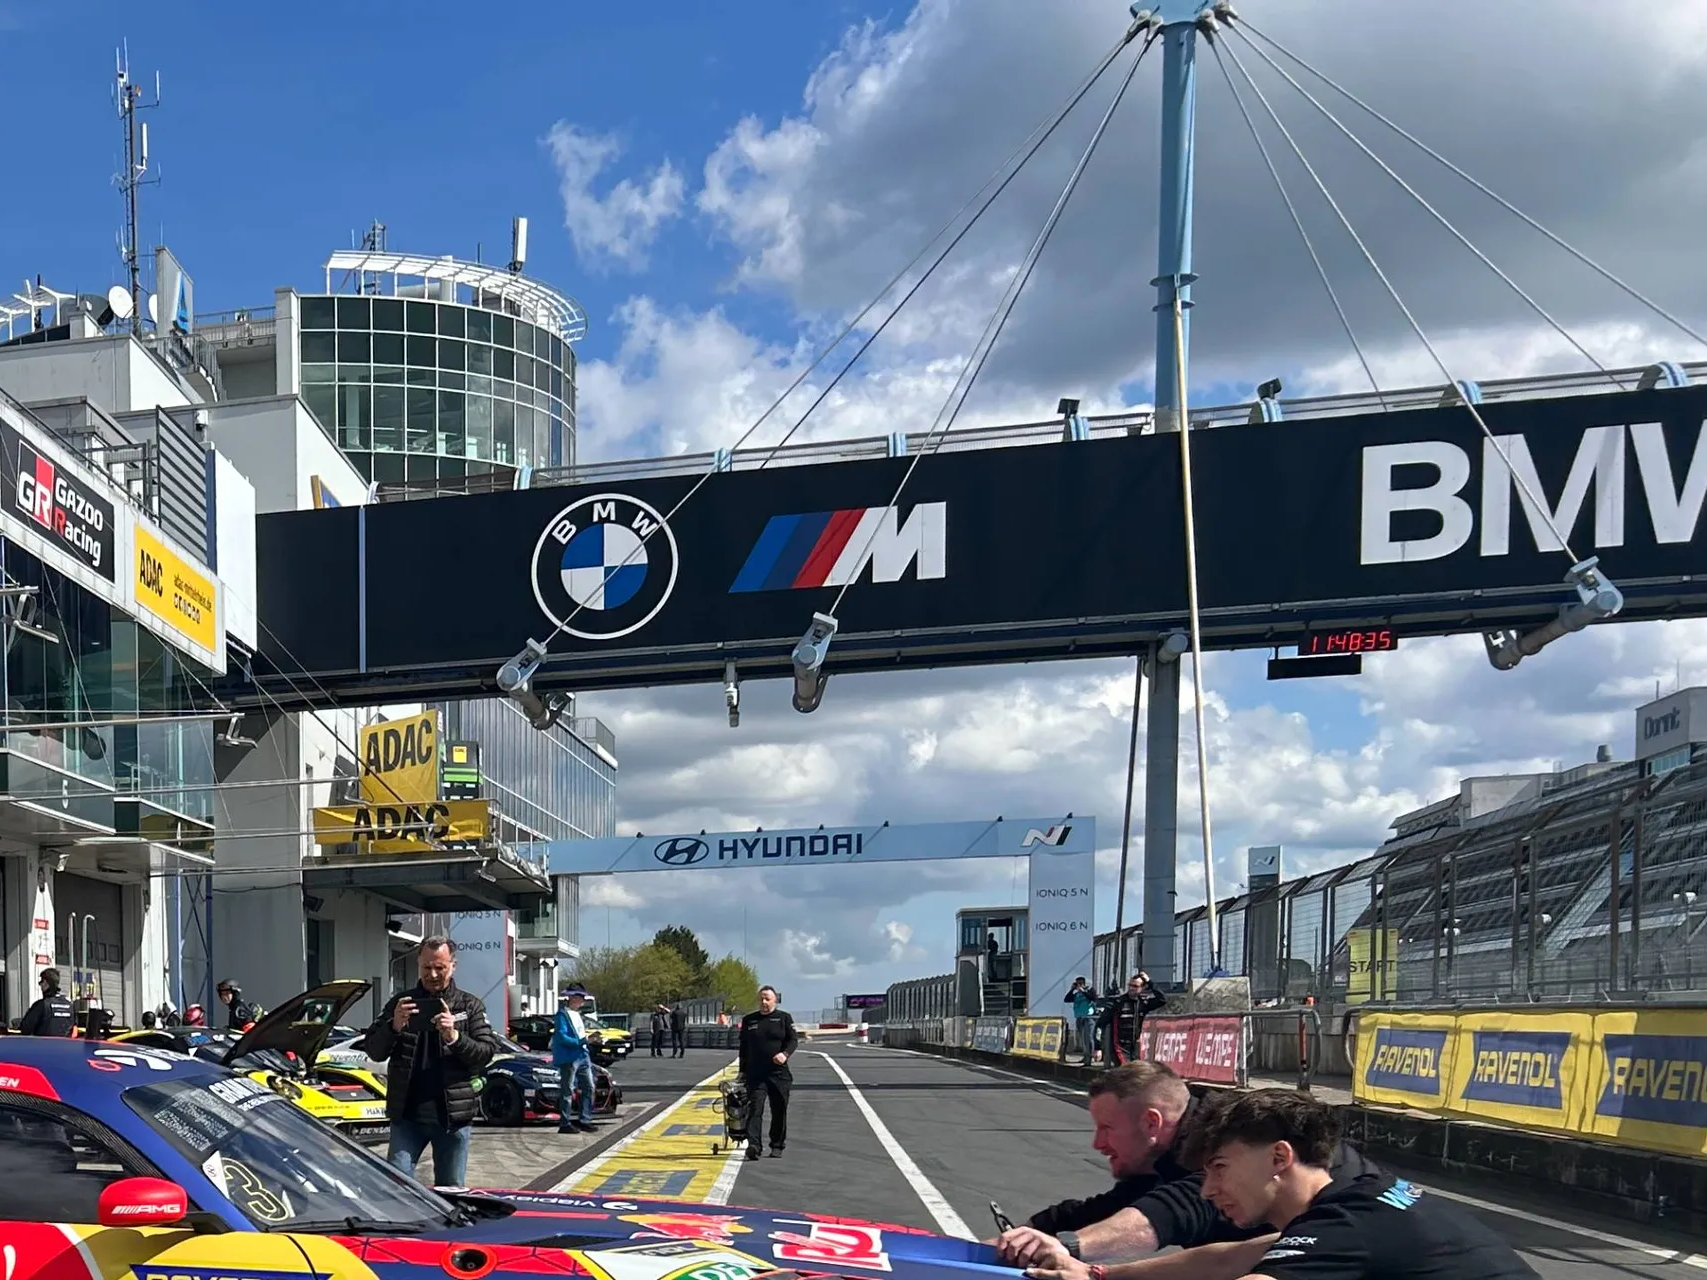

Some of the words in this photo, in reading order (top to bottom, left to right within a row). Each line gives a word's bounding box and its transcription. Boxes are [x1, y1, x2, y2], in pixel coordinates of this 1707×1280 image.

[18, 470, 51, 525] GR
[55, 477, 104, 532] GAZOO
[54, 508, 101, 567] Racing
[552, 500, 658, 546] BMW
[139, 548, 163, 598] ADAC
[1311, 630, 1391, 652] 11:48:35
[364, 718, 433, 777] ADAC
[351, 803, 451, 842] ADAC
[718, 832, 863, 860] HYUNDAI
[1036, 888, 1068, 898] IONIQ
[1070, 887, 1078, 897] 5
[1079, 887, 1089, 896] N
[457, 941, 483, 951] ONIQ
[493, 940, 501, 949] N
[1035, 921, 1068, 932] IONIQ
[1069, 920, 1078, 931] 6
[1079, 920, 1089, 930] N
[1372, 1044, 1437, 1078] RAVENOL
[1474, 1050, 1555, 1088] RAVENOL
[1612, 1057, 1707, 1101] RAVEN
[135, 1203, 181, 1214] AMG
[220, 1156, 289, 1222] 3
